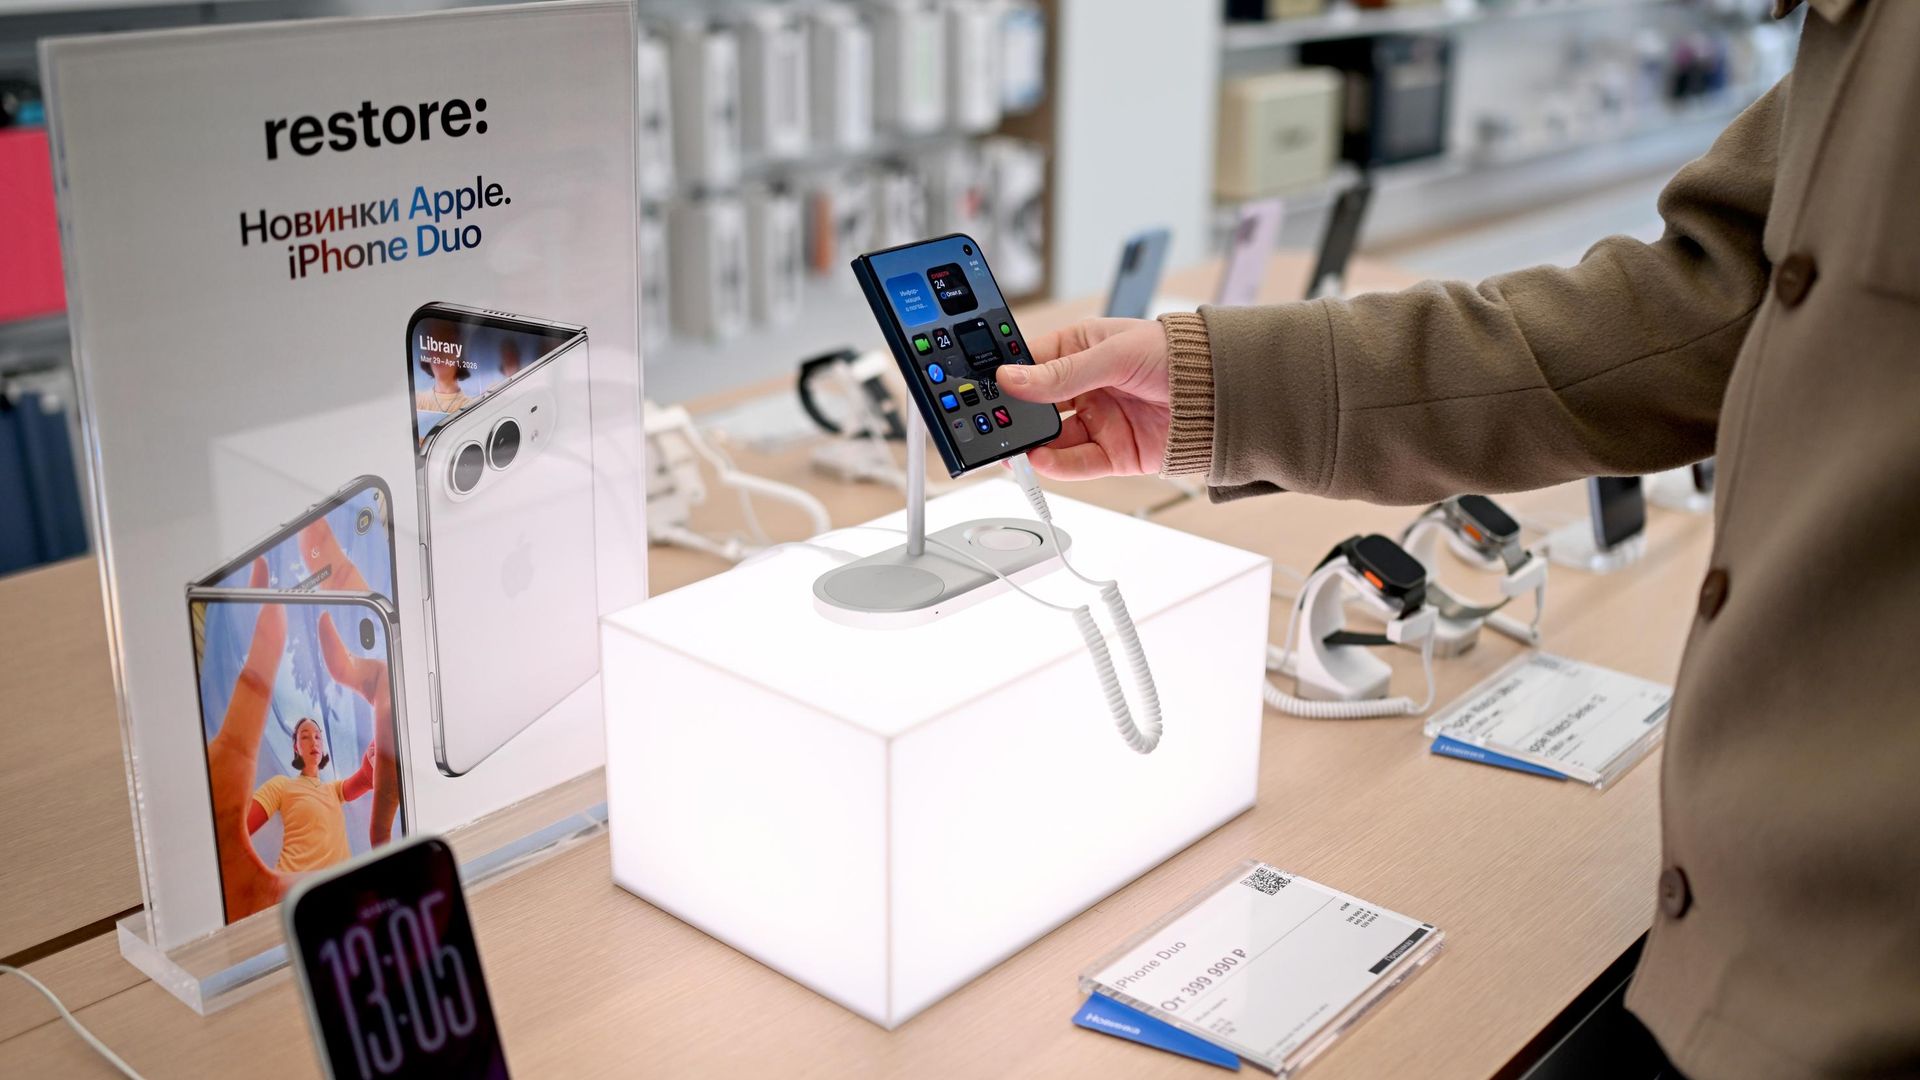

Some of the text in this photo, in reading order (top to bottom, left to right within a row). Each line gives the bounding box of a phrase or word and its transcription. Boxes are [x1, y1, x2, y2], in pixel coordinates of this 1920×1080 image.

[264, 98, 488, 161] restore:
[240, 175, 512, 246] Новинки Apple.
[288, 224, 482, 279] iPhone Duo
[934, 279, 946, 289] 24
[419, 335, 463, 358] Library
[421, 355, 432, 363] Mar
[462, 361, 478, 370] 2026
[937, 335, 951, 348] 24
[319, 891, 478, 1080] 13:05
[1114, 941, 1187, 990] iPhone Duo
[1160, 995, 1186, 1012] От
[1181, 976, 1212, 997] 399
[1207, 957, 1239, 977] 990
